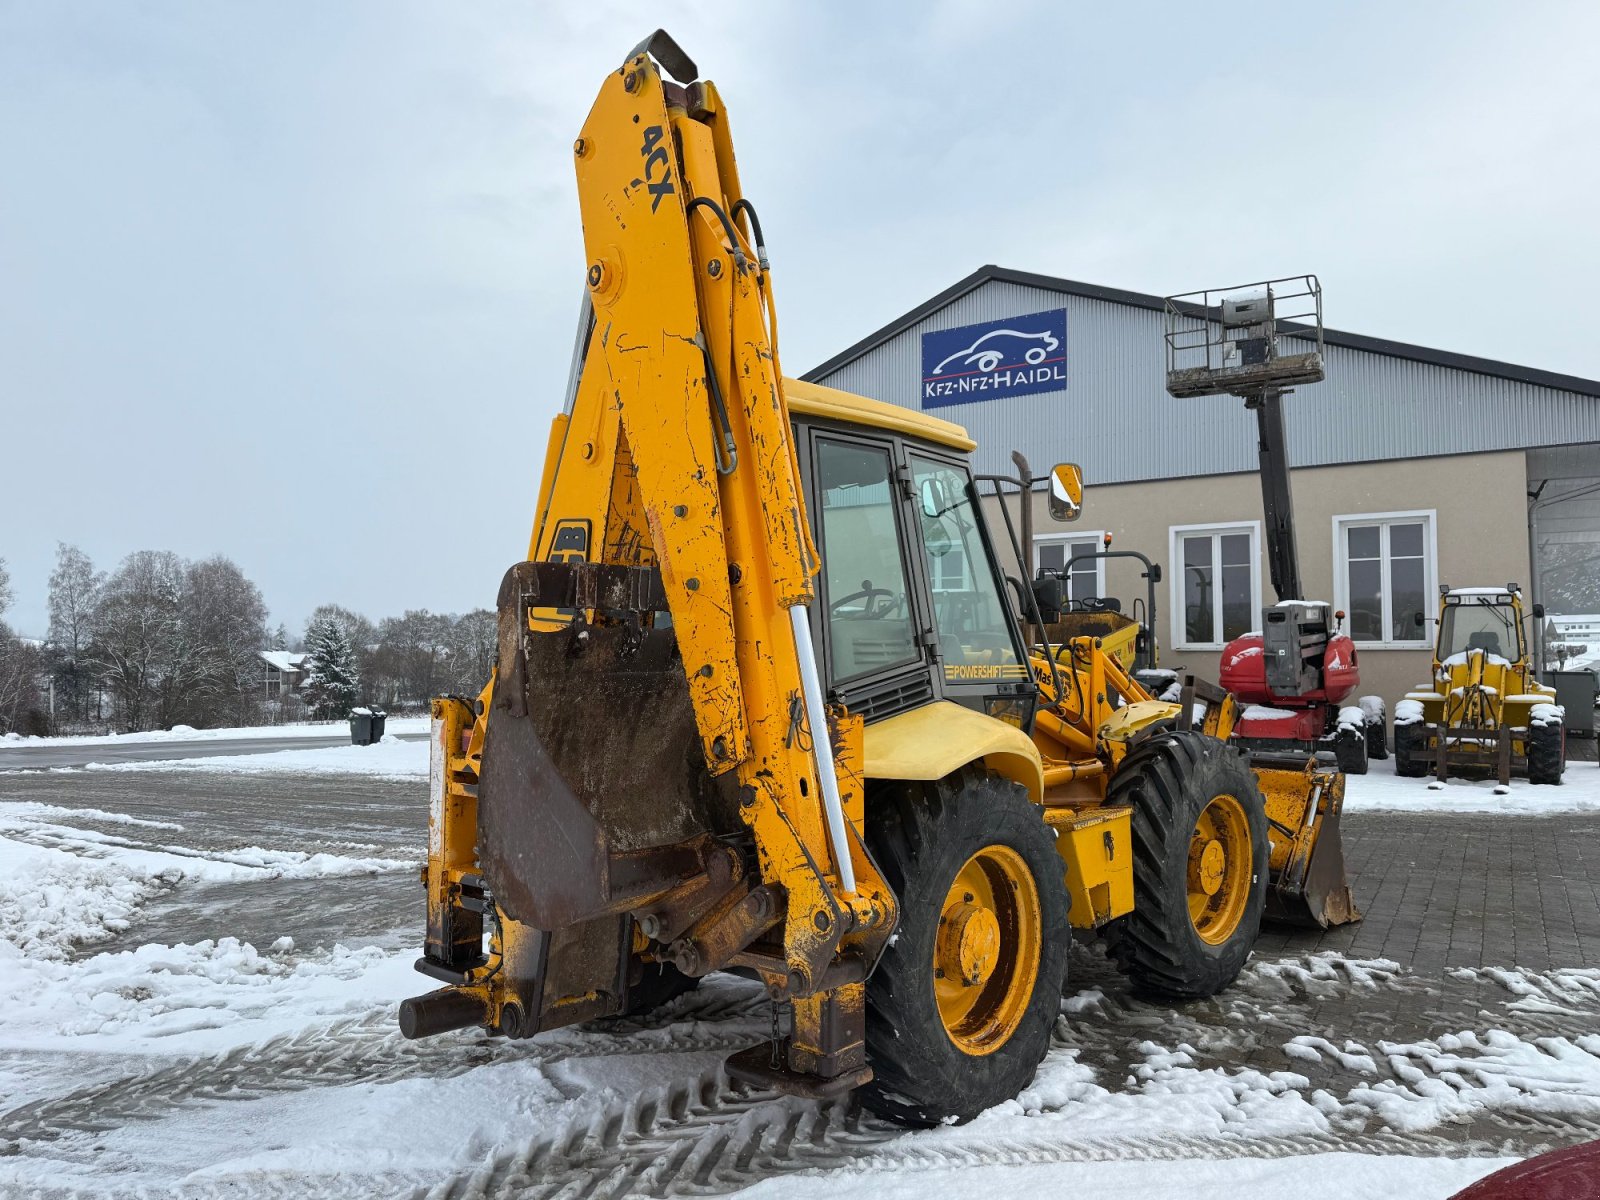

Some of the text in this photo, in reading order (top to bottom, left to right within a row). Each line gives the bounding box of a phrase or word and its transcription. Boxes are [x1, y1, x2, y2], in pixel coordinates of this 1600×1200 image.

[641, 125, 675, 215] 4CX
[953, 664, 1002, 679] POWERSHIFT
[1034, 665, 1053, 686] Mas
